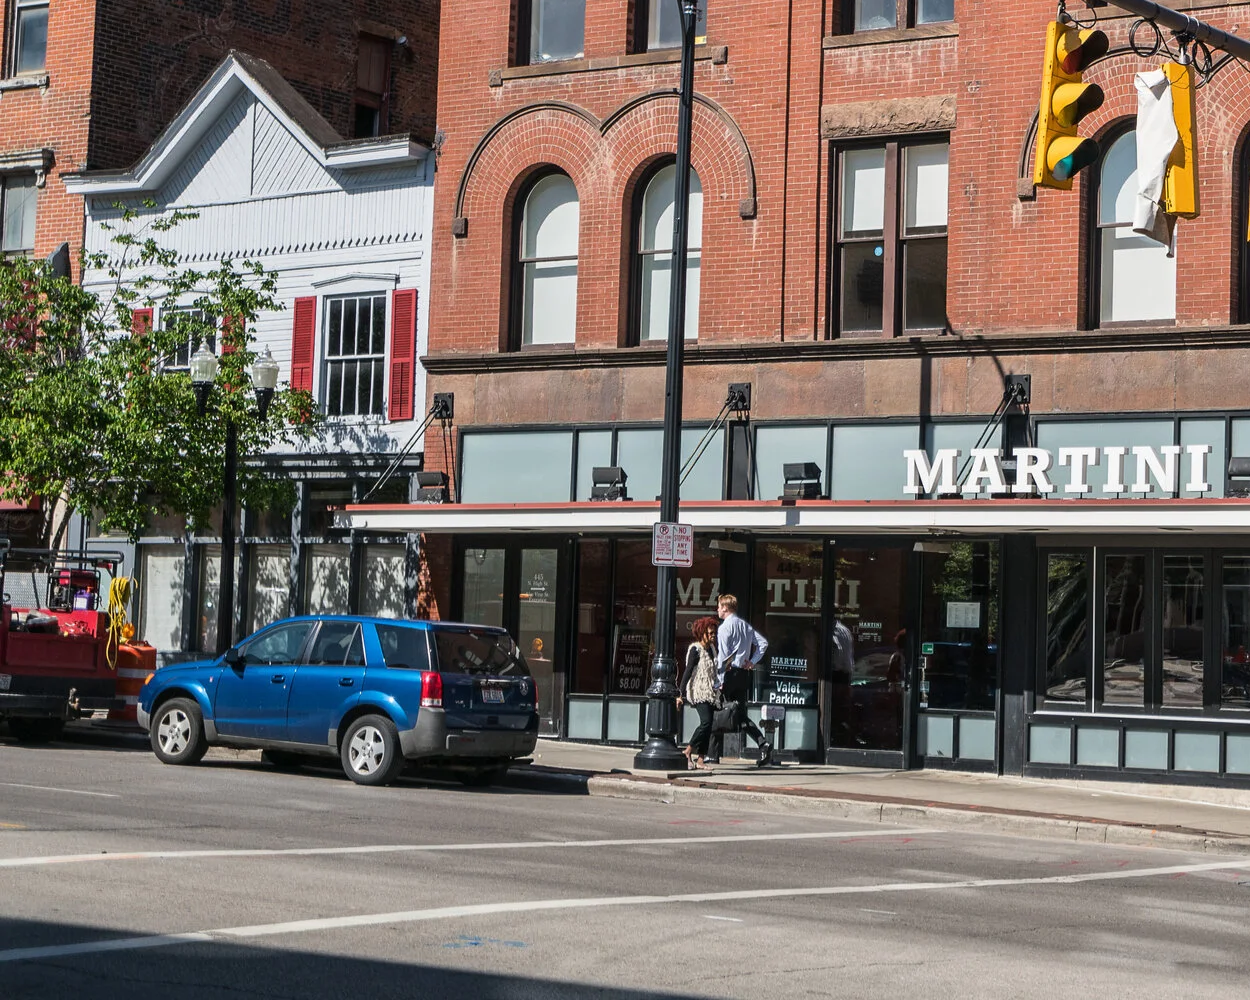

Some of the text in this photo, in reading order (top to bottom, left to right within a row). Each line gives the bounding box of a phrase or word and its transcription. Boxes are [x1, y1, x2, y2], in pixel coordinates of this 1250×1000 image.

[903, 445, 1213, 494] MARTINI
[678, 527, 687, 535] NO
[624, 654, 641, 664] Valet
[770, 656, 808, 666] MARTINI
[619, 664, 643, 676] Parking
[619, 677, 641, 689] $8.00
[776, 681, 801, 694] Valet
